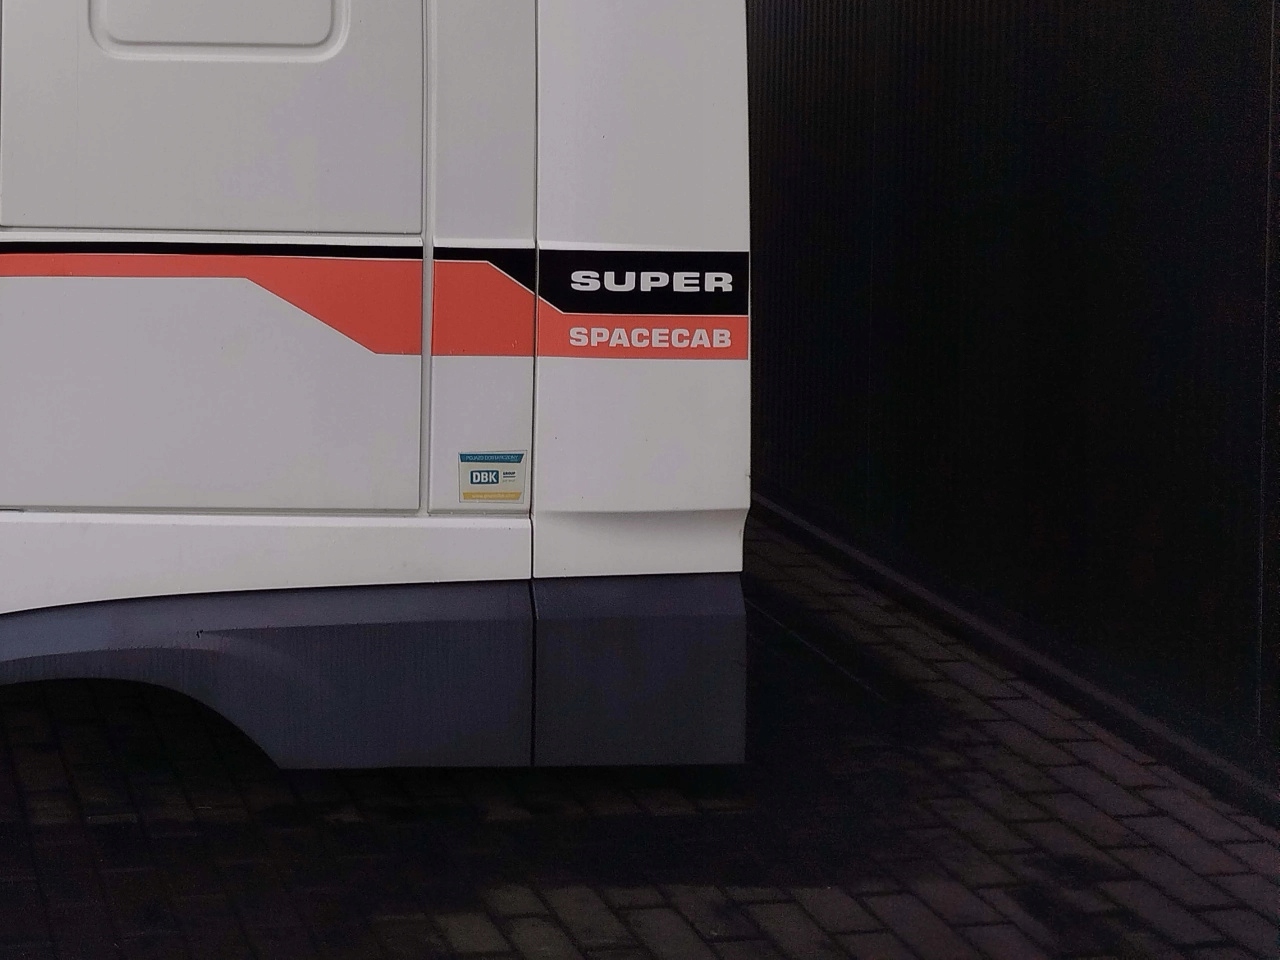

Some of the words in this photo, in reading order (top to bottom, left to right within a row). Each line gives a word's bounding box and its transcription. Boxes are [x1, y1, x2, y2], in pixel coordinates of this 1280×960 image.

[570, 270, 734, 293] SUPER
[569, 327, 732, 348] SPACECAB
[472, 472, 497, 482] DBK
